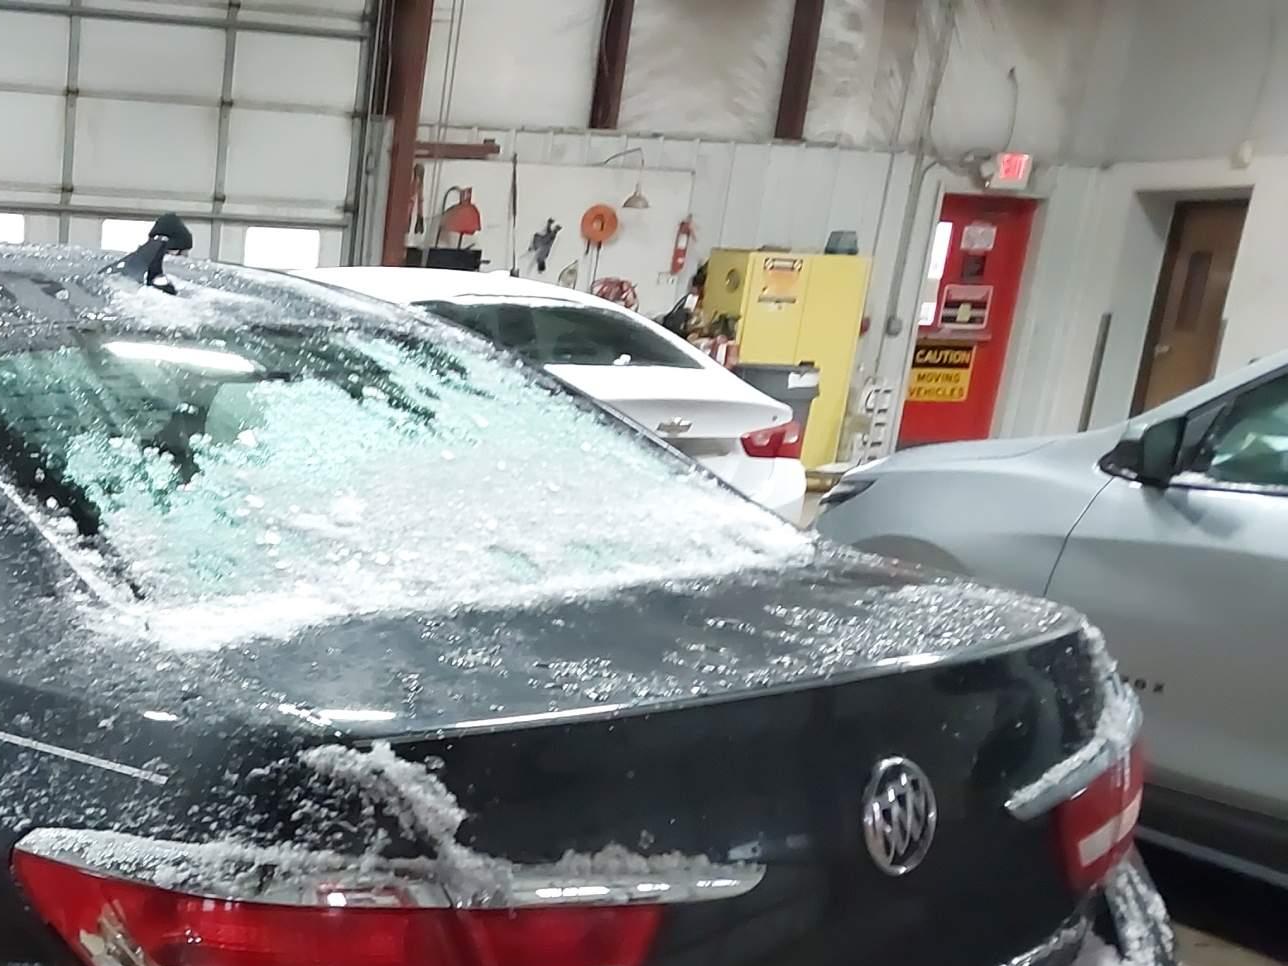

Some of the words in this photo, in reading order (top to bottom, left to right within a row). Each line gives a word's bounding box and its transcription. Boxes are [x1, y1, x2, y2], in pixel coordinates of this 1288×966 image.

[915, 349, 971, 364] CAUTION
[917, 373, 961, 384] MOVING
[909, 386, 964, 397] VEHICLES
